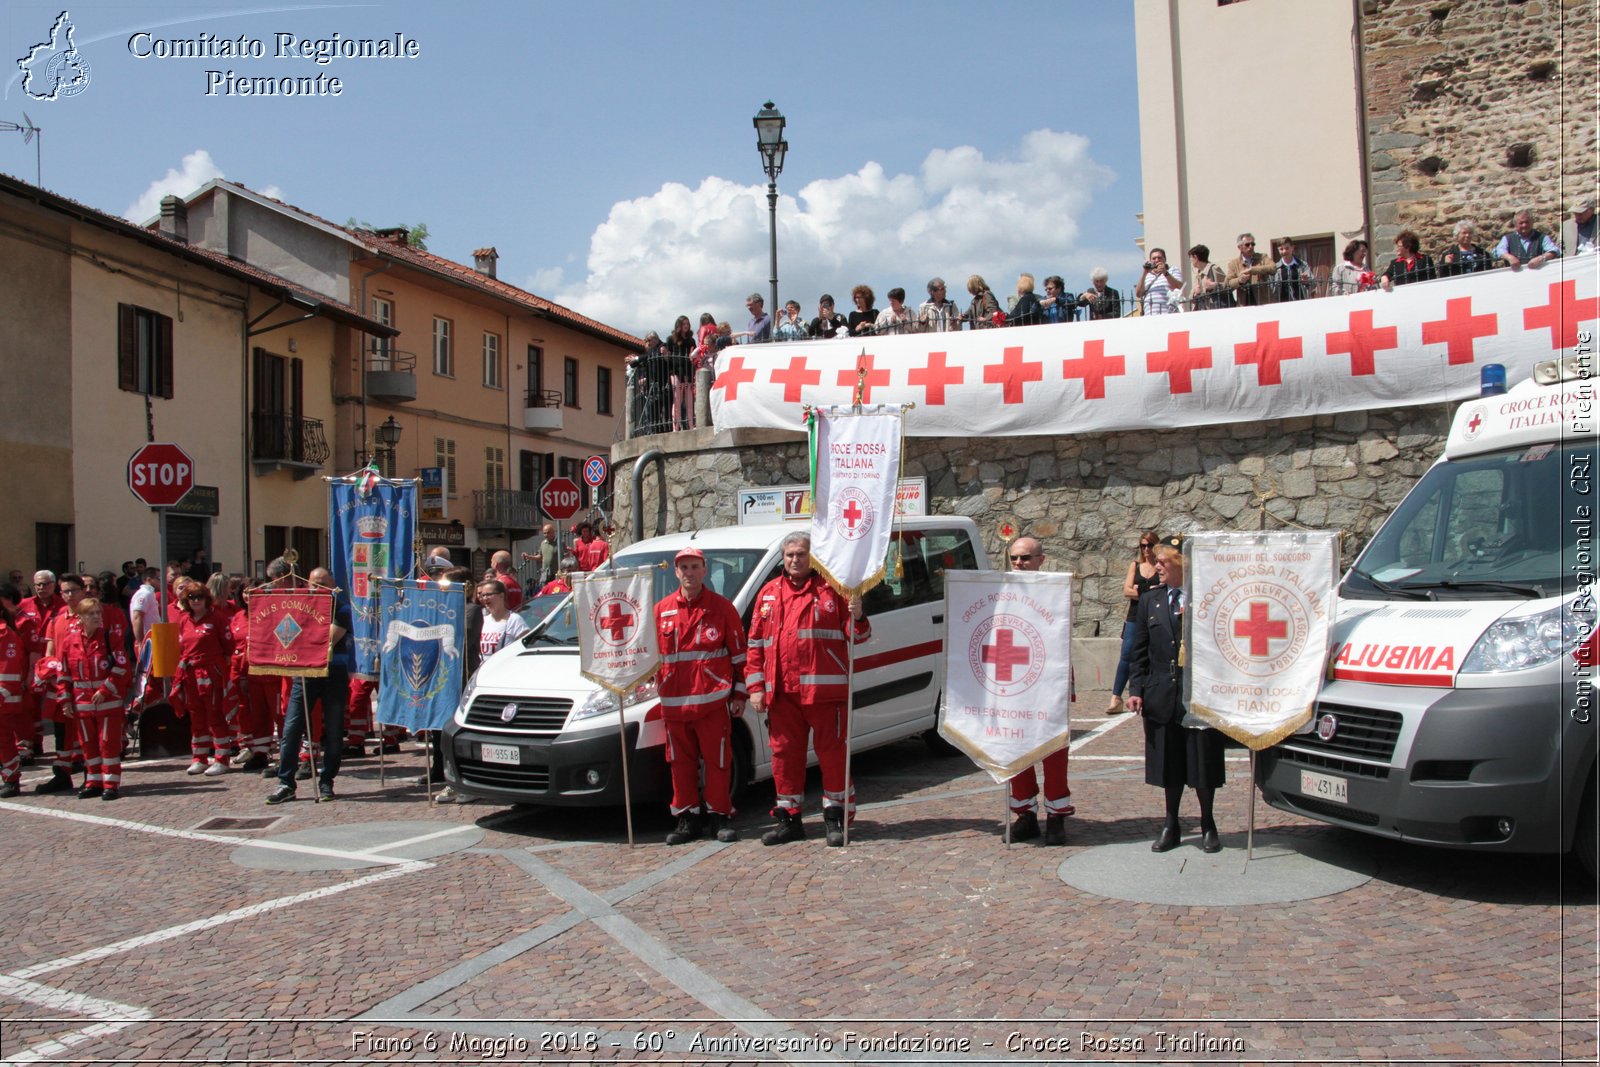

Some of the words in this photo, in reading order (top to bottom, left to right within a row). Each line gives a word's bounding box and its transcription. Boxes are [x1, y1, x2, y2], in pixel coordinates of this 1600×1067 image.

[1499, 397, 1546, 416] CROCE
[1549, 389, 1598, 404] ROSSA
[1509, 409, 1577, 430] ITALIANA
[831, 443, 851, 455] ROCE
[856, 443, 887, 455] ROSSA
[134, 463, 190, 486] STOP
[544, 491, 579, 507] STOP
[1213, 553, 1252, 563] VOLONTARI
[1255, 553, 1269, 562] DEL
[1273, 552, 1312, 562] SOCCORSO
[1197, 579, 1229, 621] CROCE
[1227, 563, 1276, 582] ROSSA
[1279, 567, 1327, 621] ITALIANA
[1230, 593, 1241, 604] DI
[1242, 582, 1290, 602] GINEVRA
[281, 600, 326, 625] COMUNALE
[387, 598, 412, 616] PRO
[418, 598, 457, 620] LOCO
[962, 598, 987, 624] CROCE
[987, 591, 1018, 603] ROSSA
[1021, 595, 1055, 626] ITALIANA
[1291, 601, 1302, 616] 22
[1216, 605, 1250, 671] CONVENZIONE
[1294, 616, 1308, 655] AGOSTO
[274, 653, 298, 663] FIANO
[593, 650, 623, 659] COMITATO
[625, 646, 648, 655] LOCALE
[970, 628, 987, 684] CONVENZIONE
[983, 621, 993, 632] DI
[989, 615, 1025, 629] GINEVRA
[1023, 624, 1034, 636] 22
[1031, 634, 1043, 671] AGOSTO
[1269, 654, 1295, 671] 1864
[1211, 684, 1263, 697] COMITATO
[964, 705, 1033, 720] DELEGAZIONE
[1037, 711, 1048, 721] DI
[1236, 700, 1281, 713] FIANO
[985, 726, 1024, 739] MATHI
